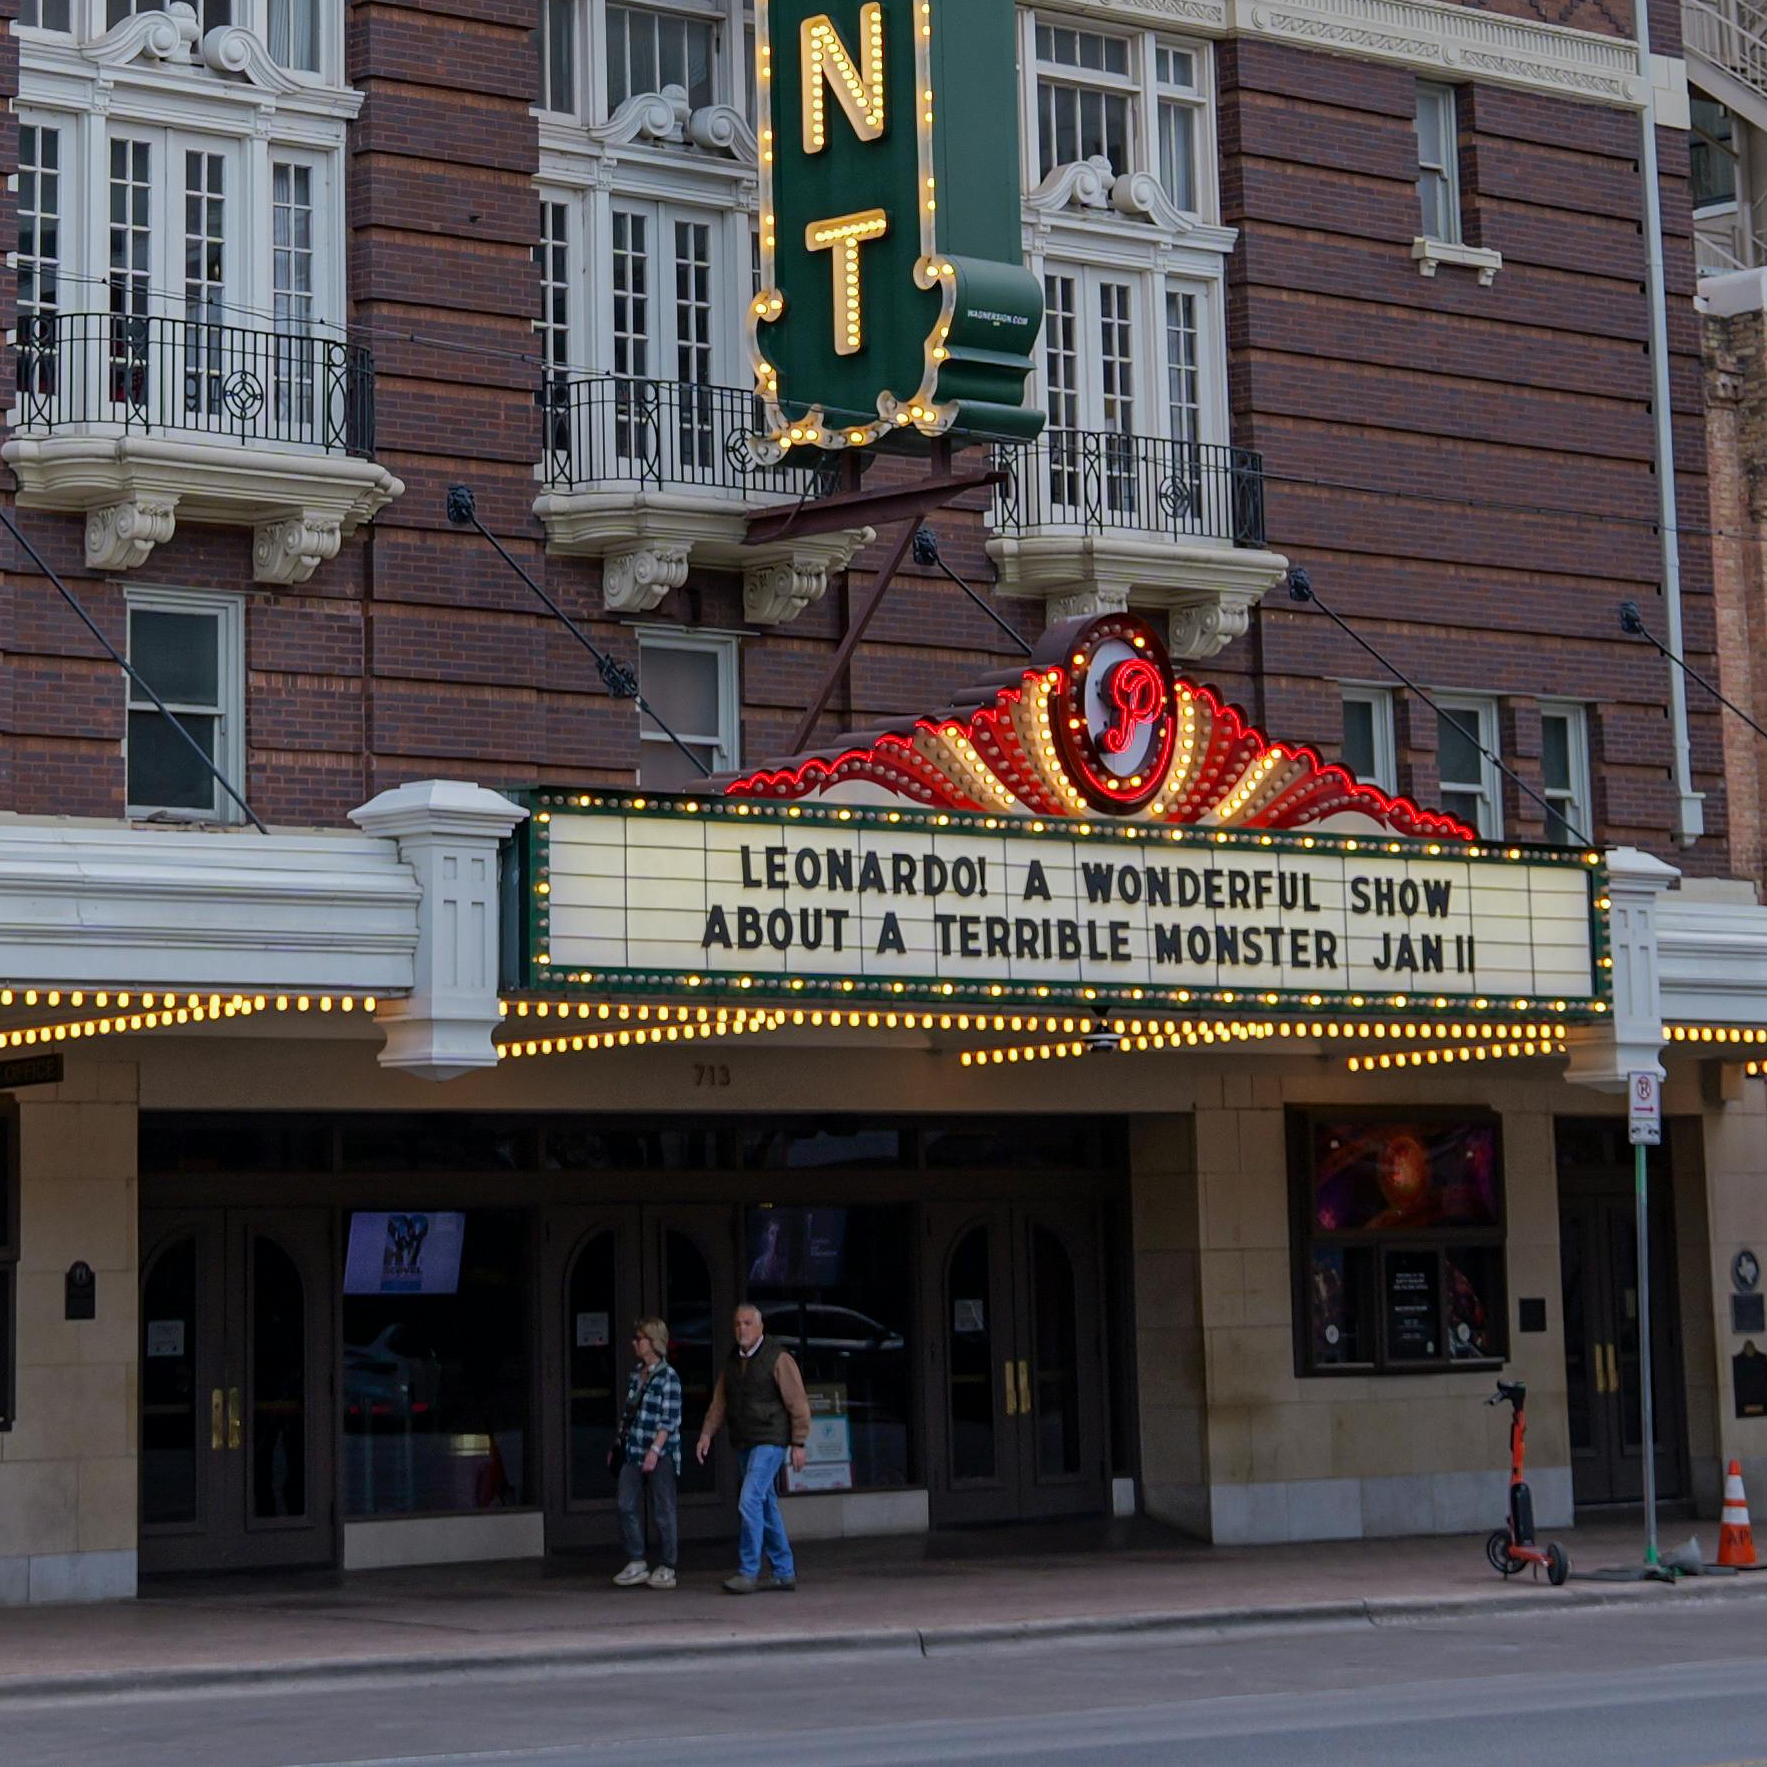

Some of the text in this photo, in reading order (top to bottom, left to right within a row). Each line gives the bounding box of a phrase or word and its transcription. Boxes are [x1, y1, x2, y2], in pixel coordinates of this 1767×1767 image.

[740, 845, 1452, 918] LEONARDO! A WONDERFUL SHOW
[701, 904, 850, 953] ABOUT
[876, 911, 907, 955] A
[934, 913, 1132, 962] TERRIBLE
[1154, 922, 1338, 970] MONSTER
[1372, 932, 1444, 973] JAN
